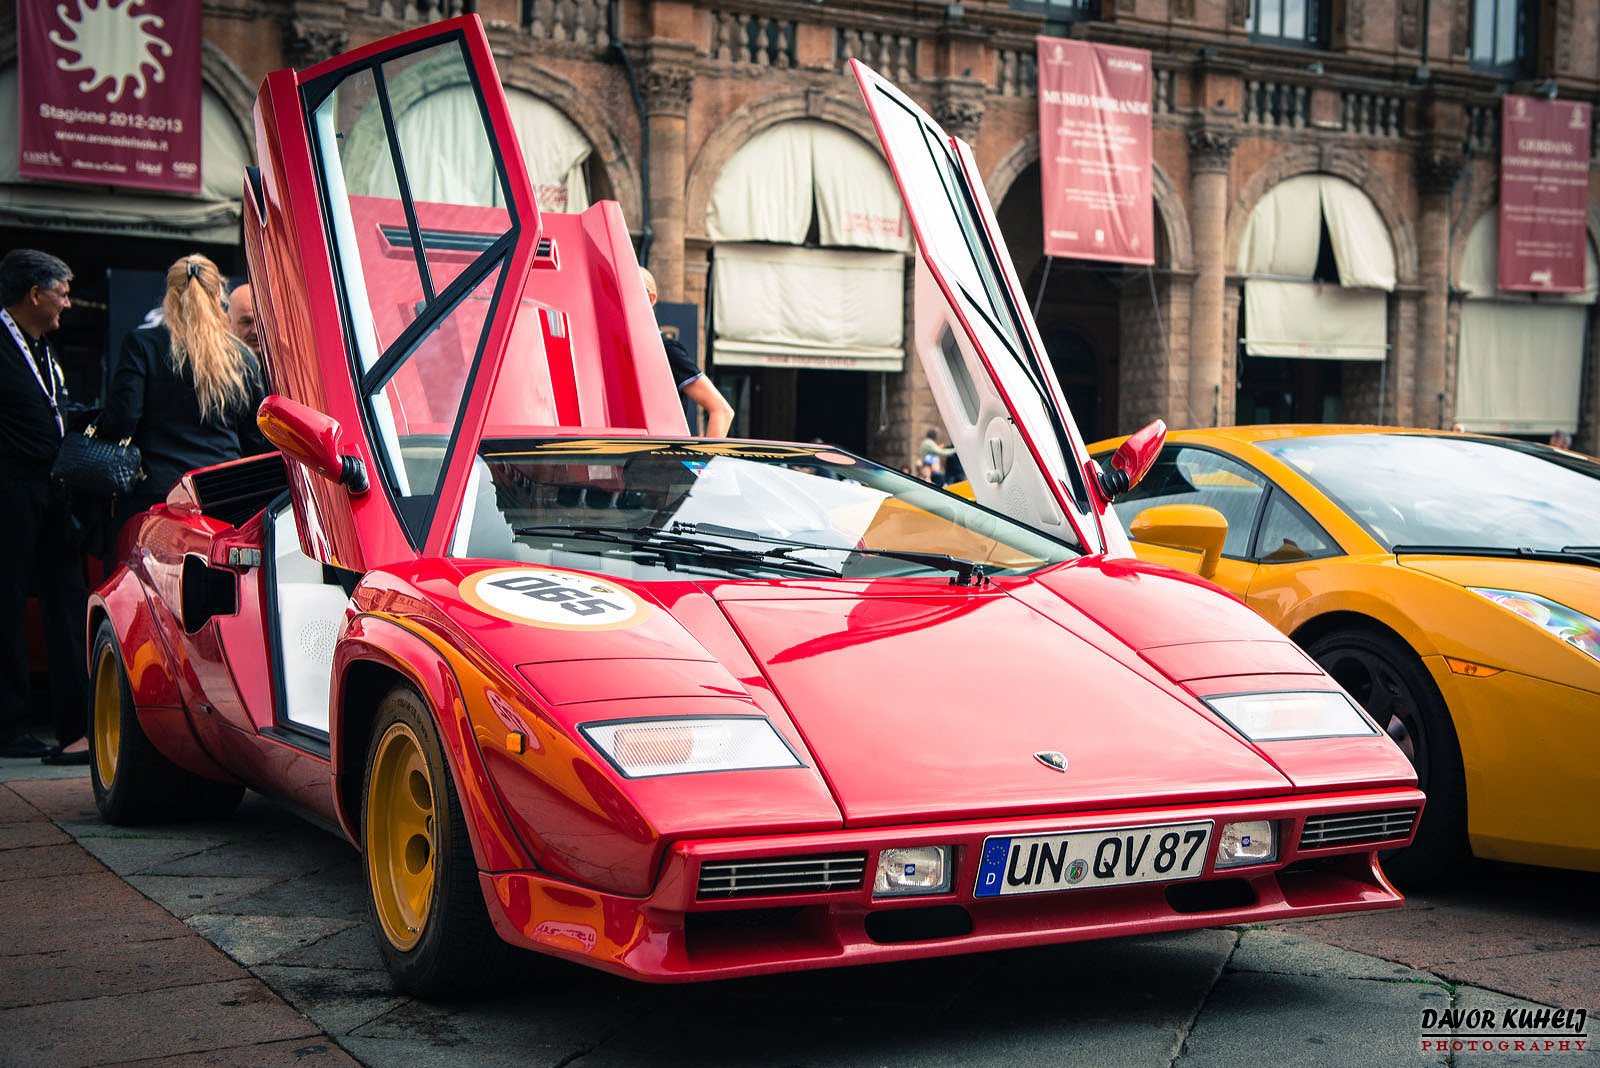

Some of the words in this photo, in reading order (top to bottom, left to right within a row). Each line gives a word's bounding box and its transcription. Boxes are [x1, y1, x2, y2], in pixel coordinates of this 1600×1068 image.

[39, 103, 107, 125] Stagione
[108, 111, 183, 134] 2012-2013
[486, 576, 626, 616] 065
[1007, 840, 1069, 886] UN
[1093, 834, 1152, 878] QV
[1153, 829, 1207, 873] 87
[985, 872, 996, 885] D
